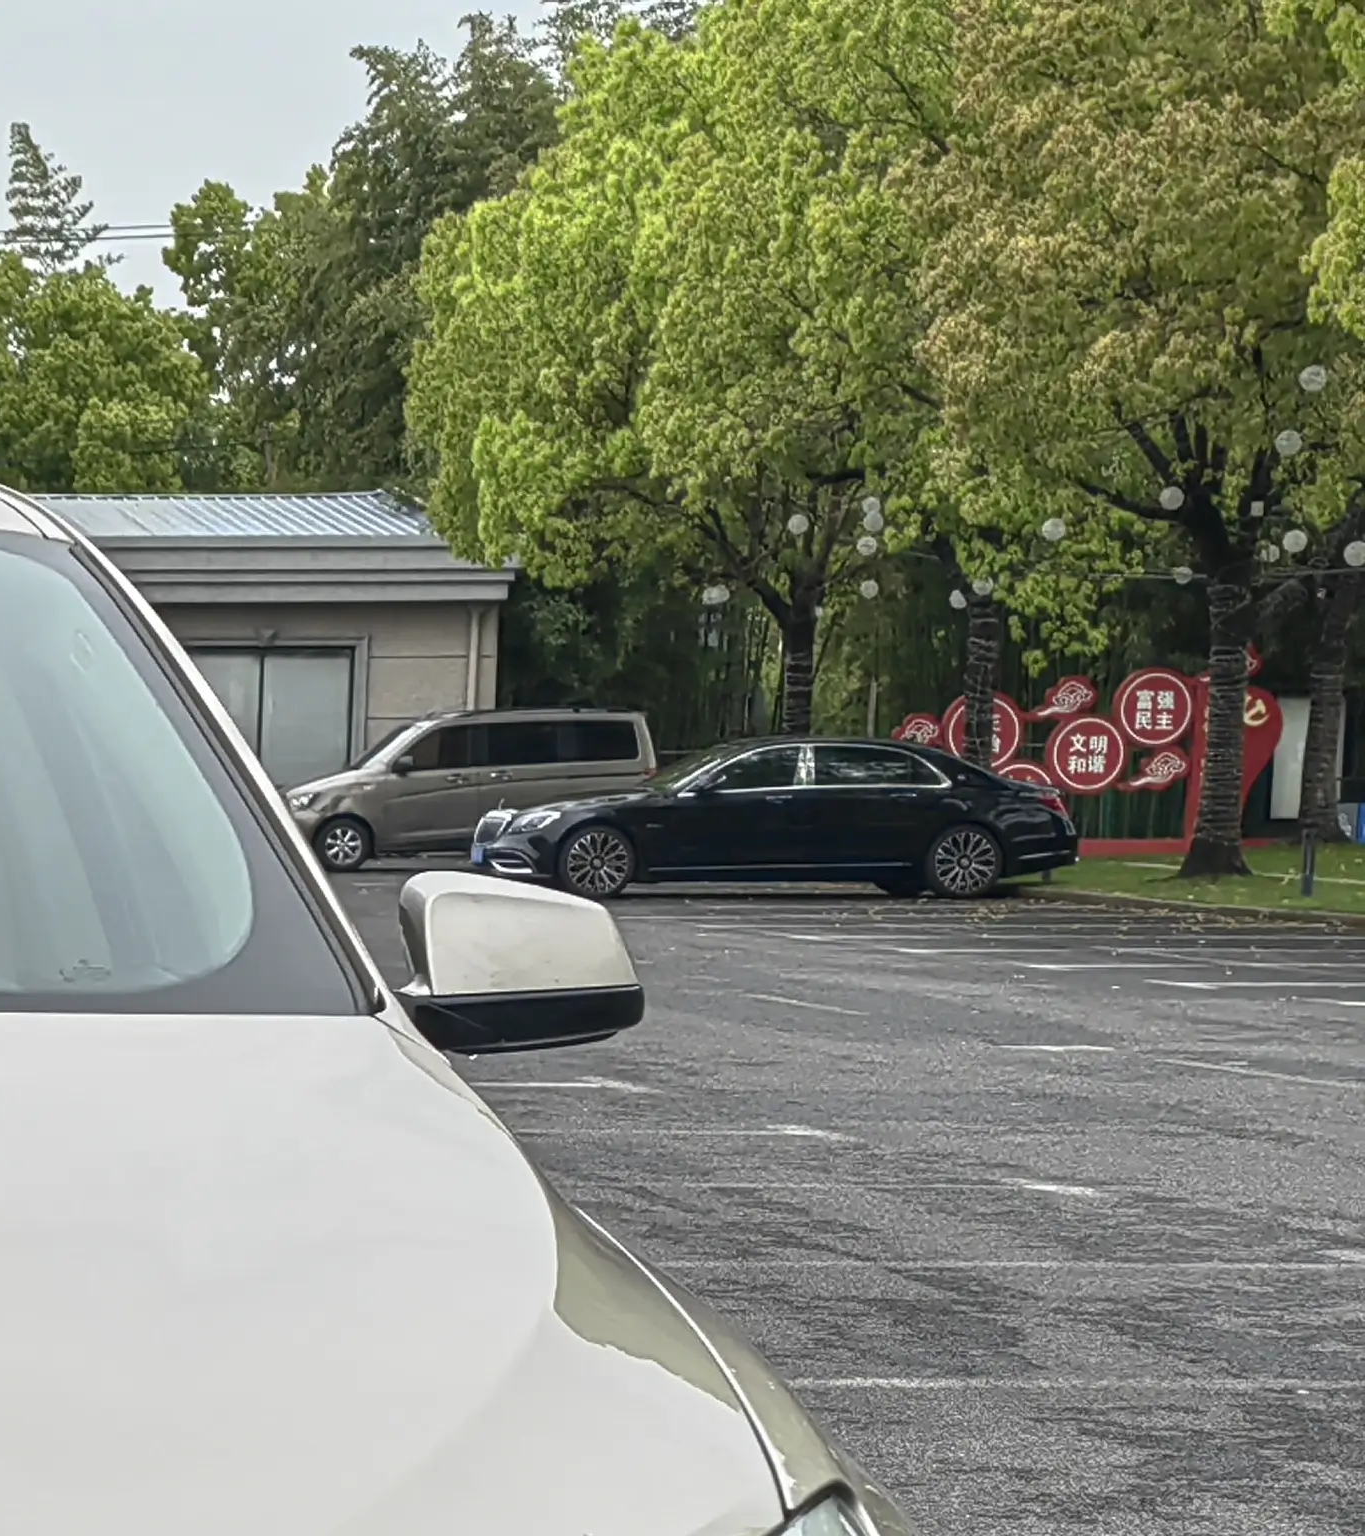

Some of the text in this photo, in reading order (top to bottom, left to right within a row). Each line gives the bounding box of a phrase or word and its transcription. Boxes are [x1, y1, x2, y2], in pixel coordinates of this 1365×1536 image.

[1136, 689, 1175, 710] 富强
[1135, 712, 1173, 730] 民主
[1070, 733, 1108, 754] 文明
[1068, 755, 1106, 775] 和谐
